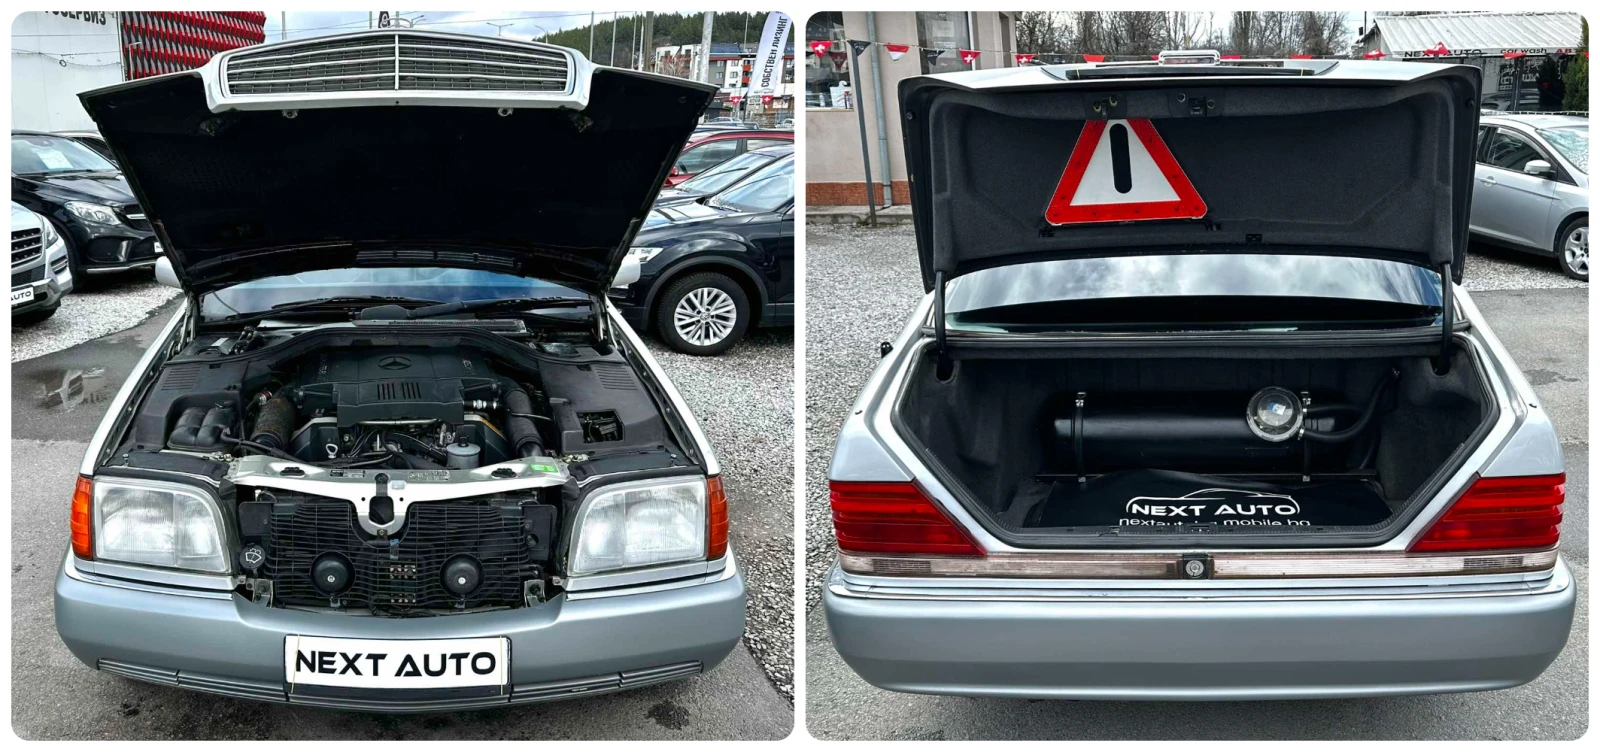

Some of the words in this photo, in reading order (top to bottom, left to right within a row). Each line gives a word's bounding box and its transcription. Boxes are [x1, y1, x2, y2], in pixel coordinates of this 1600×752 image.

[761, 49, 778, 88] СОБСТВЕН
[772, 16, 788, 49] ЛИЗИНГ
[1131, 504, 1206, 517] NEXT
[1214, 504, 1295, 516] AUTO
[296, 650, 388, 677] NEXT
[394, 651, 496, 677] AUTO
